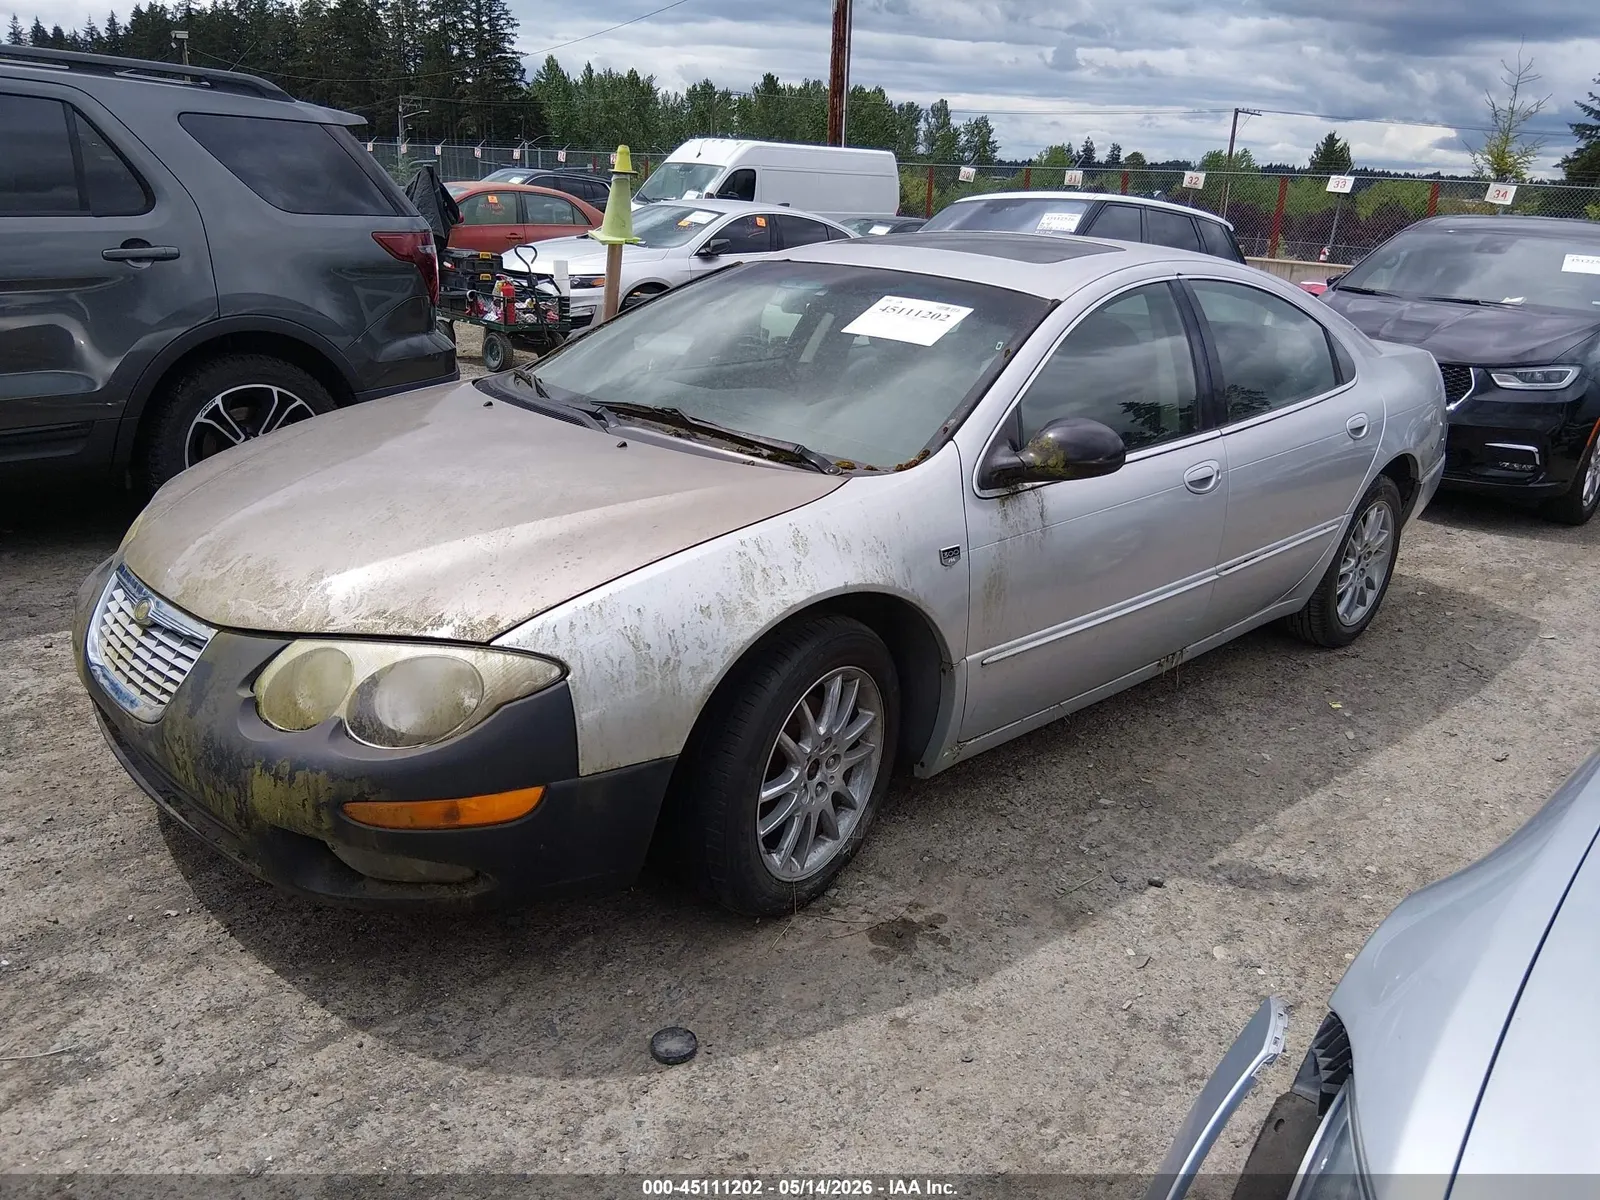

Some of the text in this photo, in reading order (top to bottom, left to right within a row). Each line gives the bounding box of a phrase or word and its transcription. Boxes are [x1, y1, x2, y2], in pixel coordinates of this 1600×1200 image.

[1187, 176, 1200, 186] 32
[1333, 180, 1347, 189] 33
[1494, 189, 1508, 200] 34
[879, 305, 951, 322] 45111202
[943, 549, 960, 559] 300
